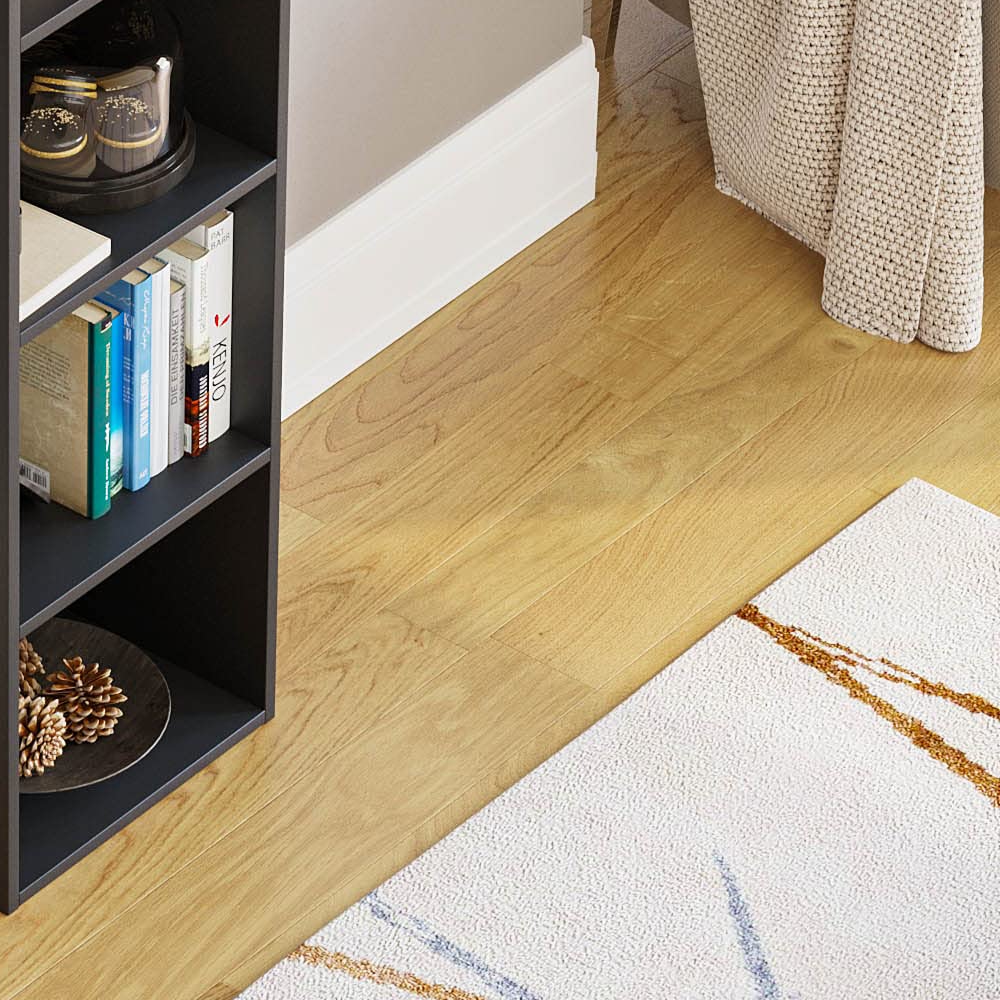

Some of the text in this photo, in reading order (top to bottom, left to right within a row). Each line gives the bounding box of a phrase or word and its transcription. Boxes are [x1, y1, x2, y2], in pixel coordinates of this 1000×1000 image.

[211, 228, 224, 241] PAT
[170, 309, 180, 405] DIE EINSAMKEIT
[212, 337, 228, 402] KENJO
